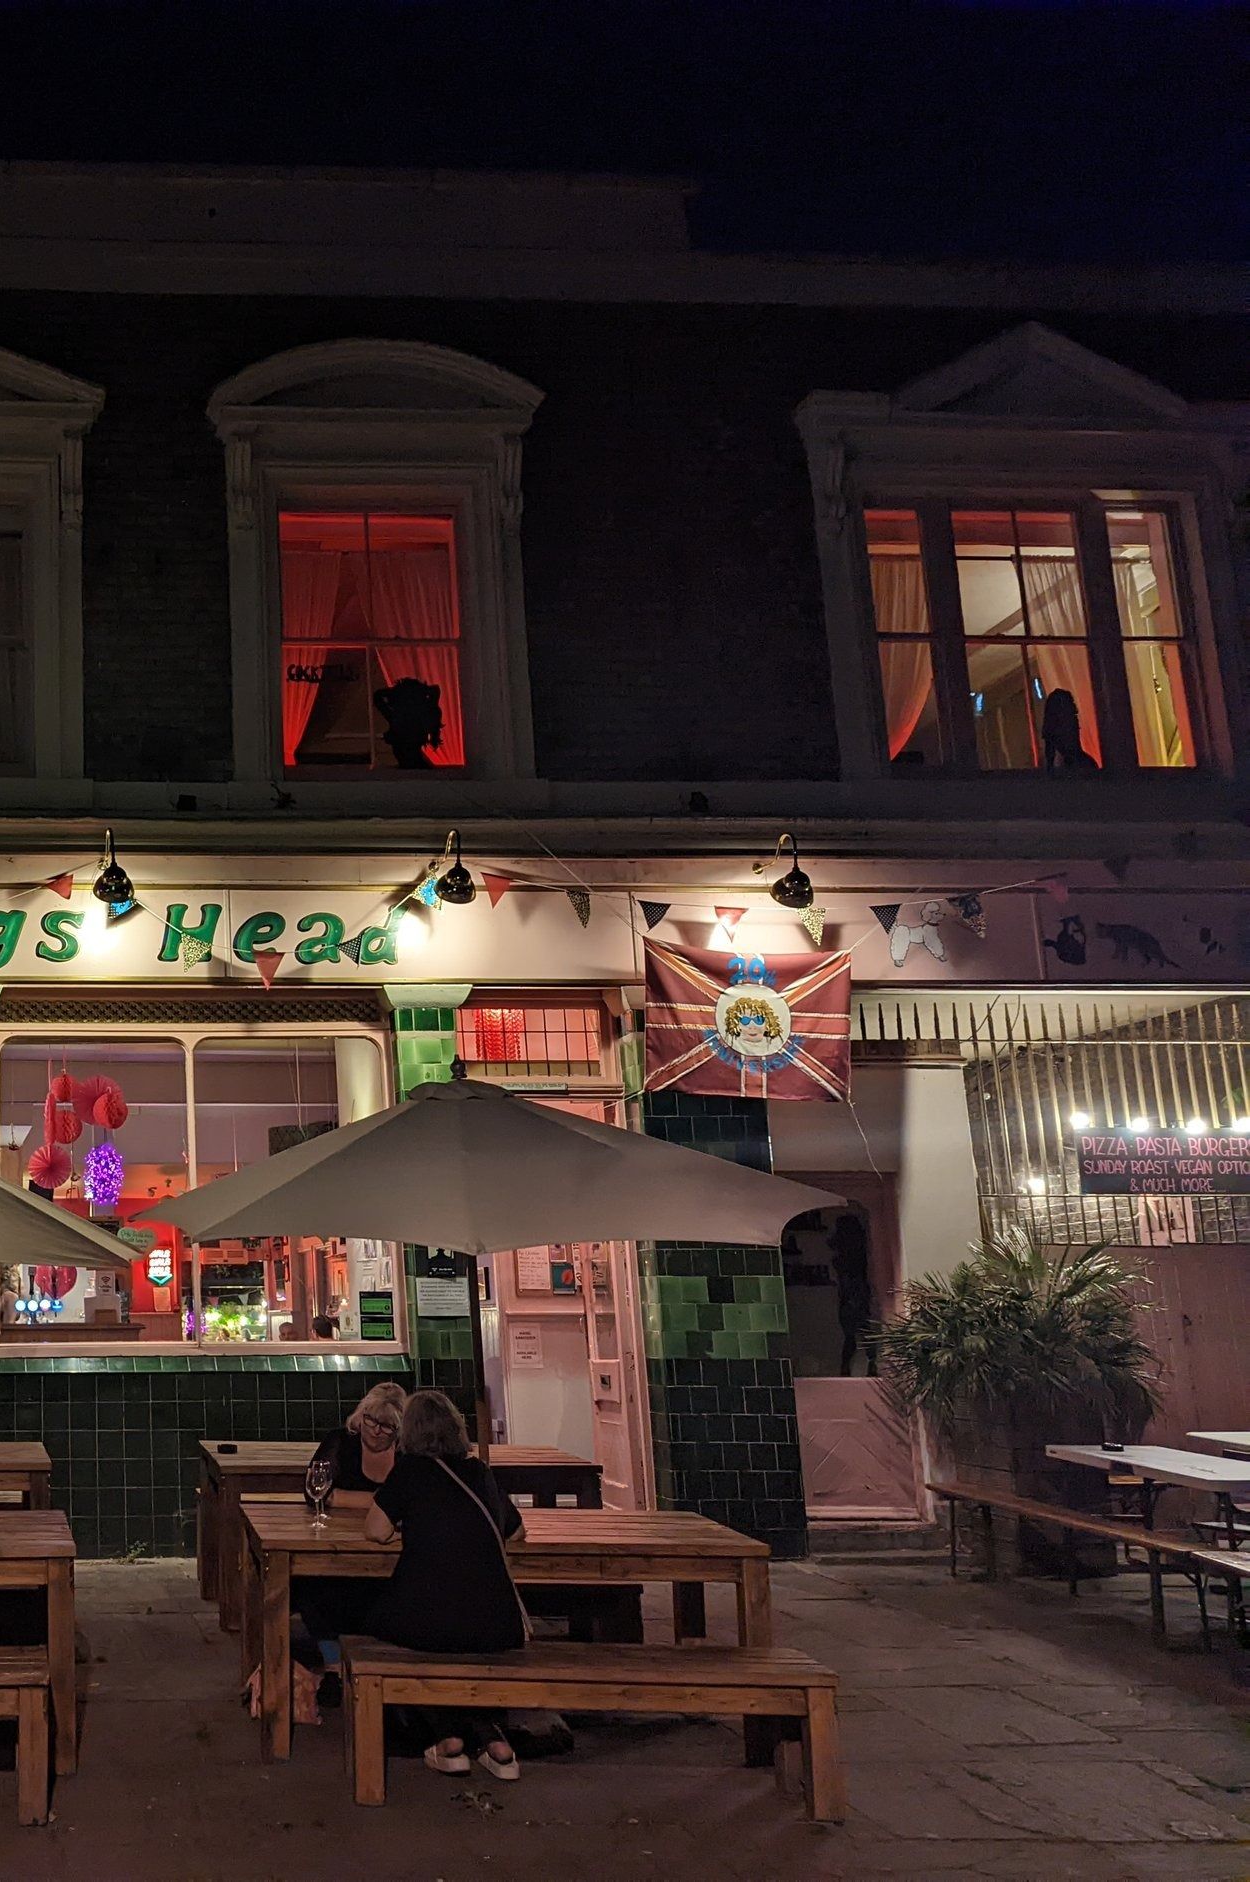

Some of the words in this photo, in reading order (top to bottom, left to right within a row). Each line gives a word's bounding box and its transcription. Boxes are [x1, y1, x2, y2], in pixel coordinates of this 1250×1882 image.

[157, 903, 411, 966] Head
[1081, 1136, 1128, 1156] PIZZA
[1136, 1136, 1182, 1156] PASTA
[1188, 1137, 1250, 1157] BURGER
[1083, 1160, 1127, 1175] SUNDAY
[1131, 1160, 1169, 1175] ROAST
[1174, 1159, 1213, 1175] VEGAN
[1130, 1179, 1138, 1192] &
[1143, 1178, 1175, 1192] MUCH
